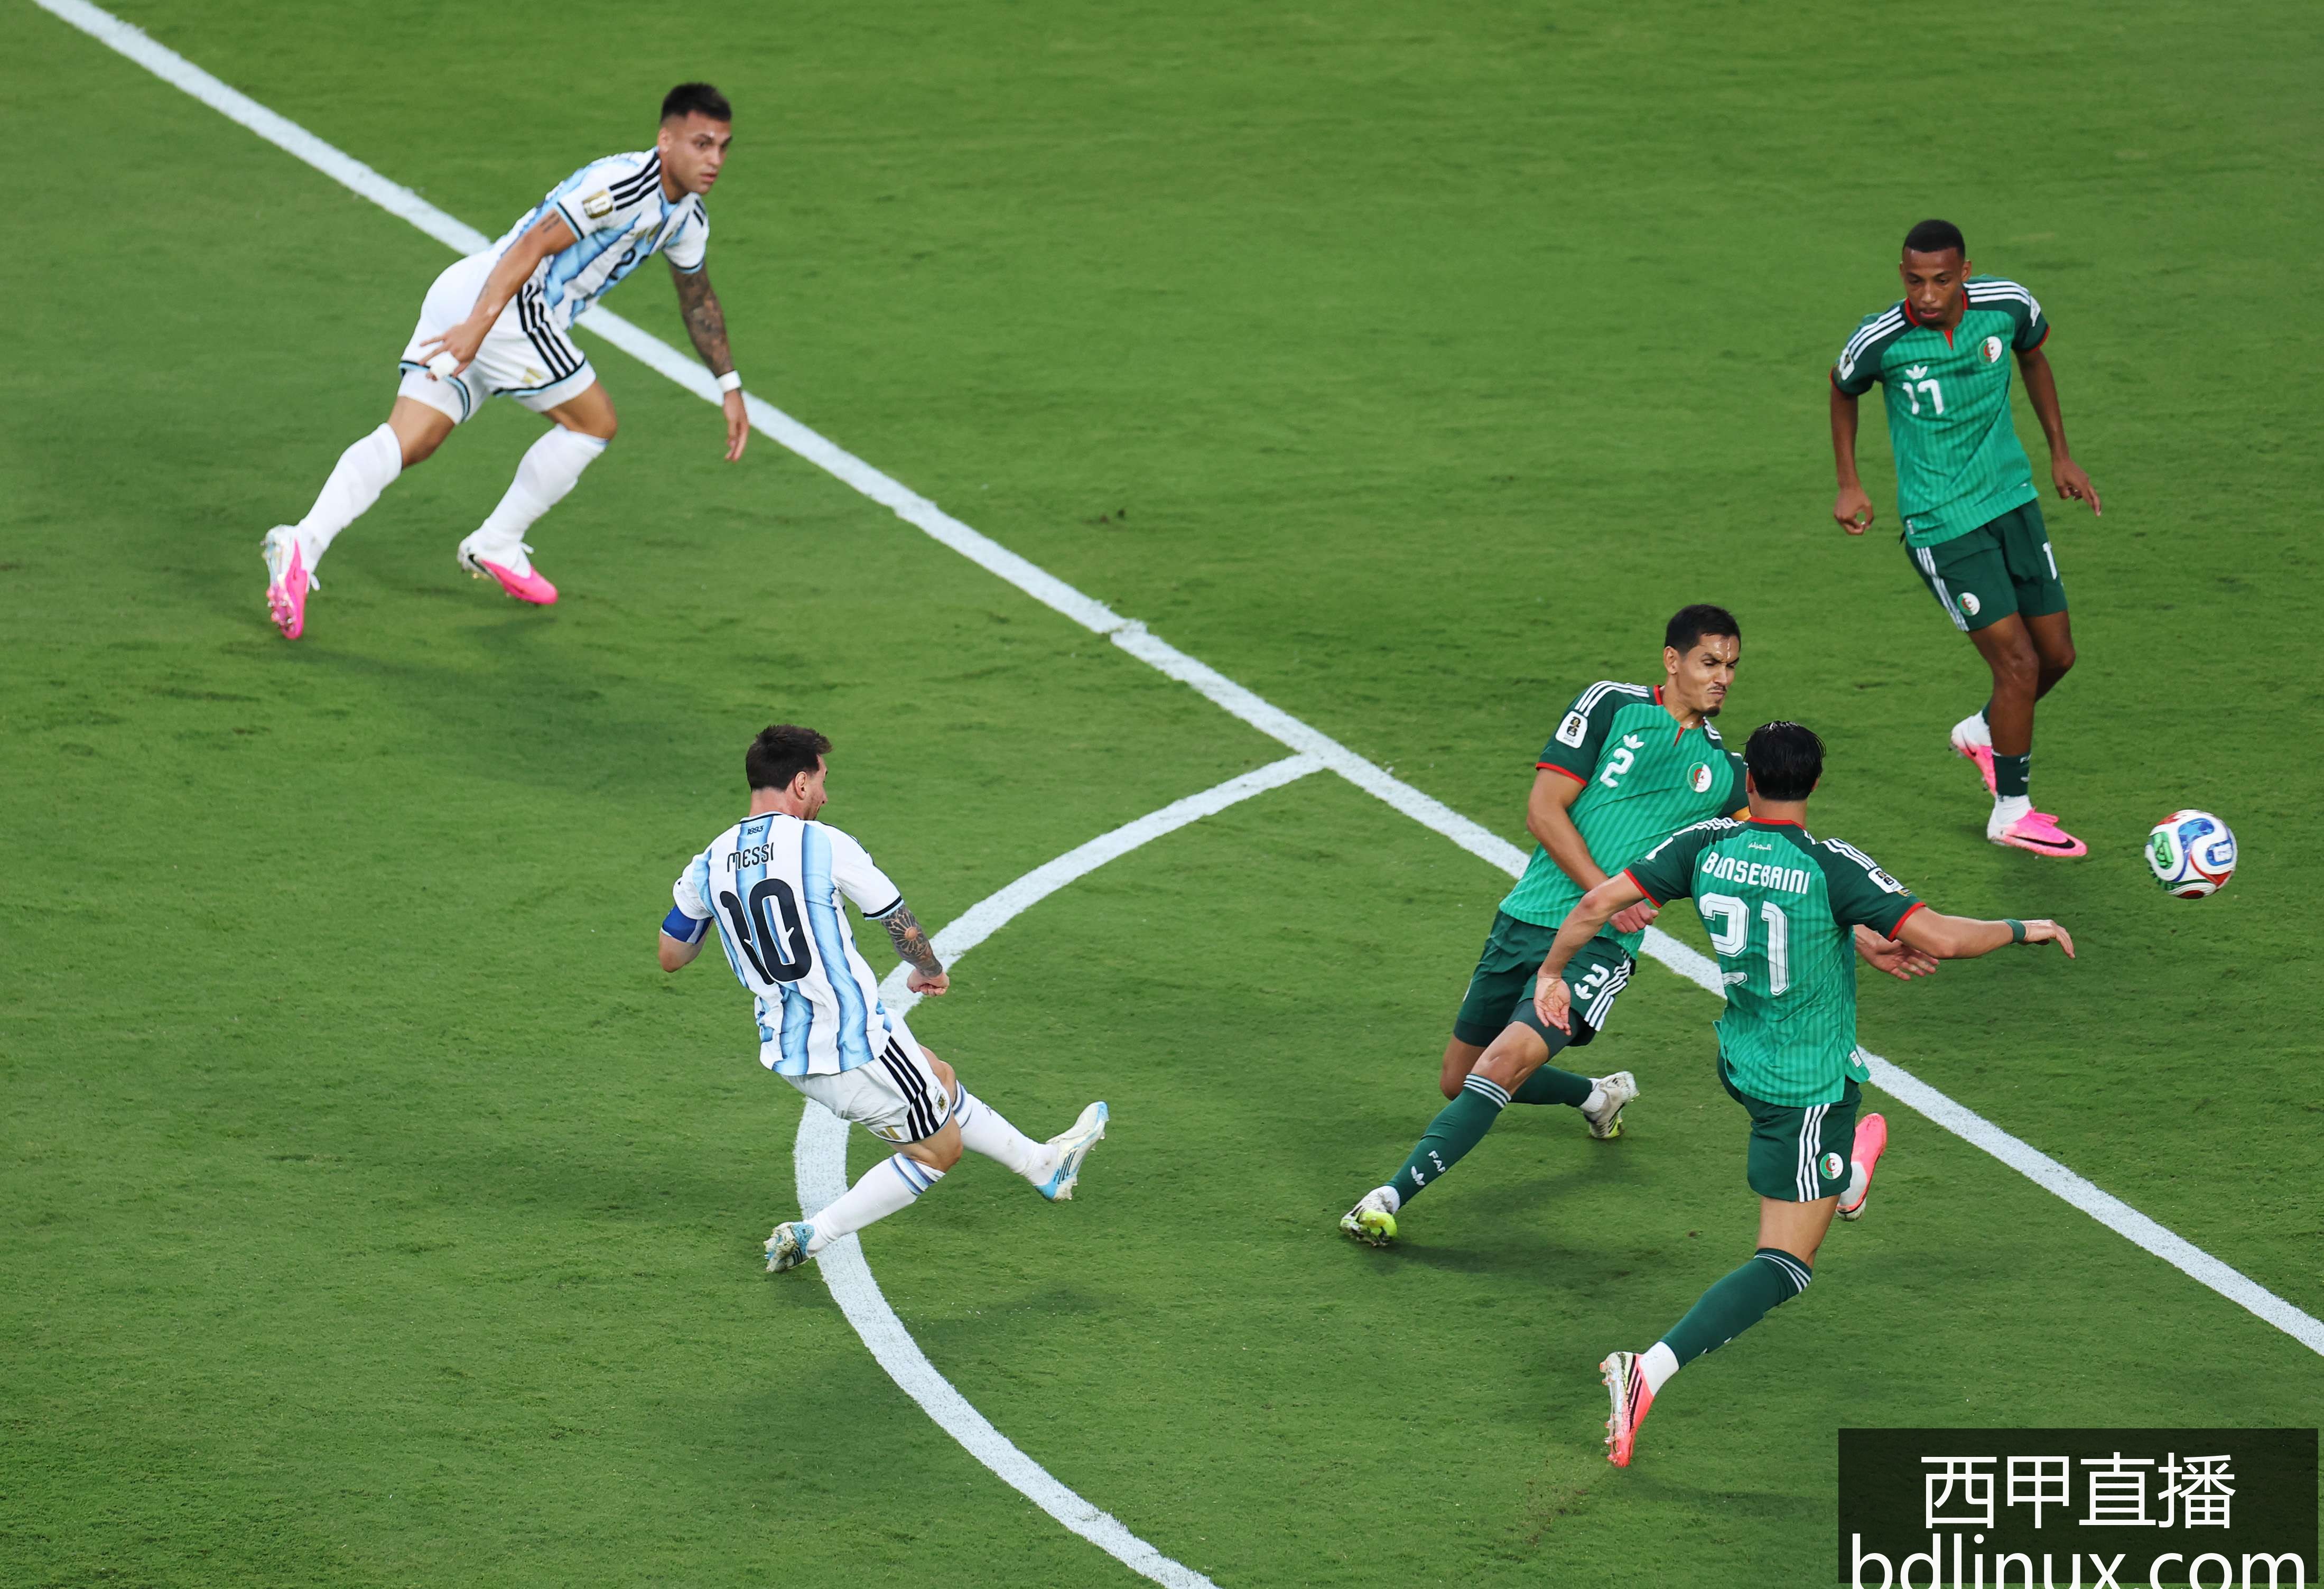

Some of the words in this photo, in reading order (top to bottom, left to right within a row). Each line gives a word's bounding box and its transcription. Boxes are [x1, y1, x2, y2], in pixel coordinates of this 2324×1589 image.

[1902, 378, 1944, 415] 17
[2042, 541, 2058, 580] 1
[1599, 747, 1635, 788] 2
[747, 825, 764, 835] 1893
[727, 842, 774, 873] MESSI
[719, 878, 812, 986] 10
[1699, 892, 1790, 996] 21
[1581, 963, 1610, 988] 2
